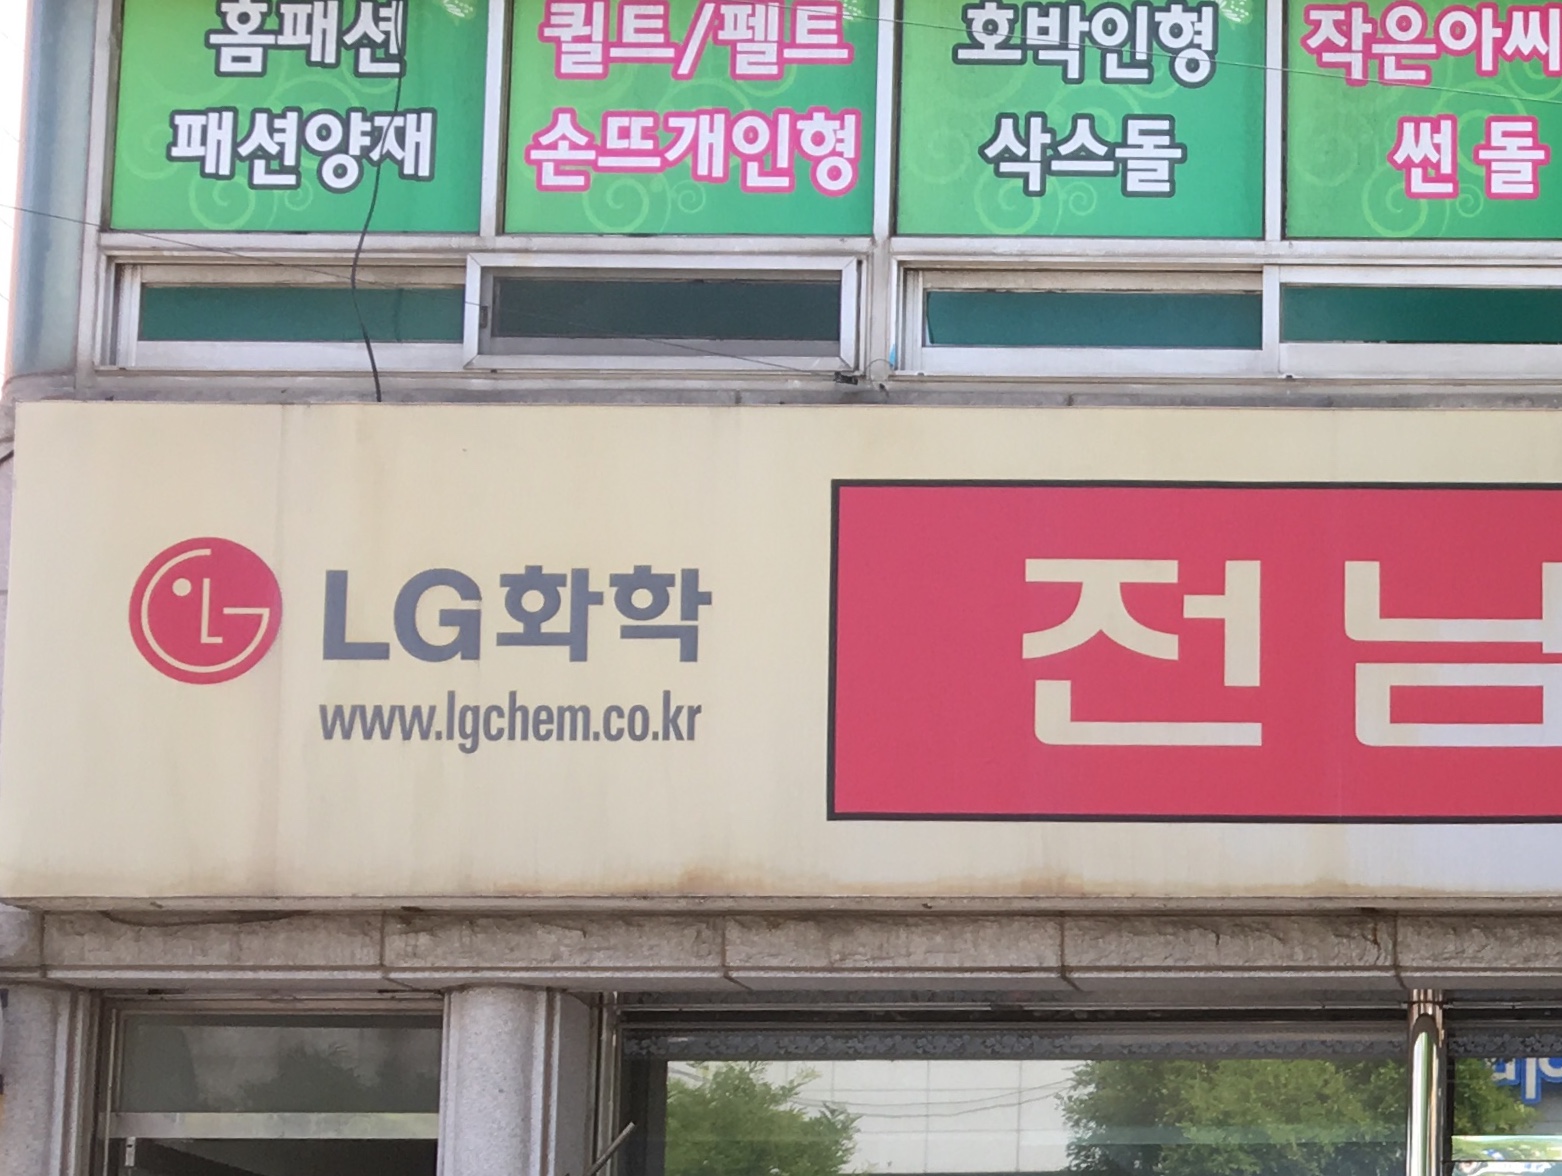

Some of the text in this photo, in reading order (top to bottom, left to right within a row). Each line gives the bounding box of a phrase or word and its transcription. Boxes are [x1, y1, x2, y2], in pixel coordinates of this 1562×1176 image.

[207, 0, 405, 75] 홈패션
[542, 0, 851, 77] 퀼트/펠트
[955, 1, 1215, 85] 호박인형
[168, 109, 435, 191] 패션양재
[528, 110, 858, 193] 손뜨개인형
[985, 115, 1184, 194] 삭스돌
[1392, 118, 1547, 196] 썬 돌
[321, 563, 714, 664] LG화학
[318, 688, 703, 756] www.lgchem.co.kr
